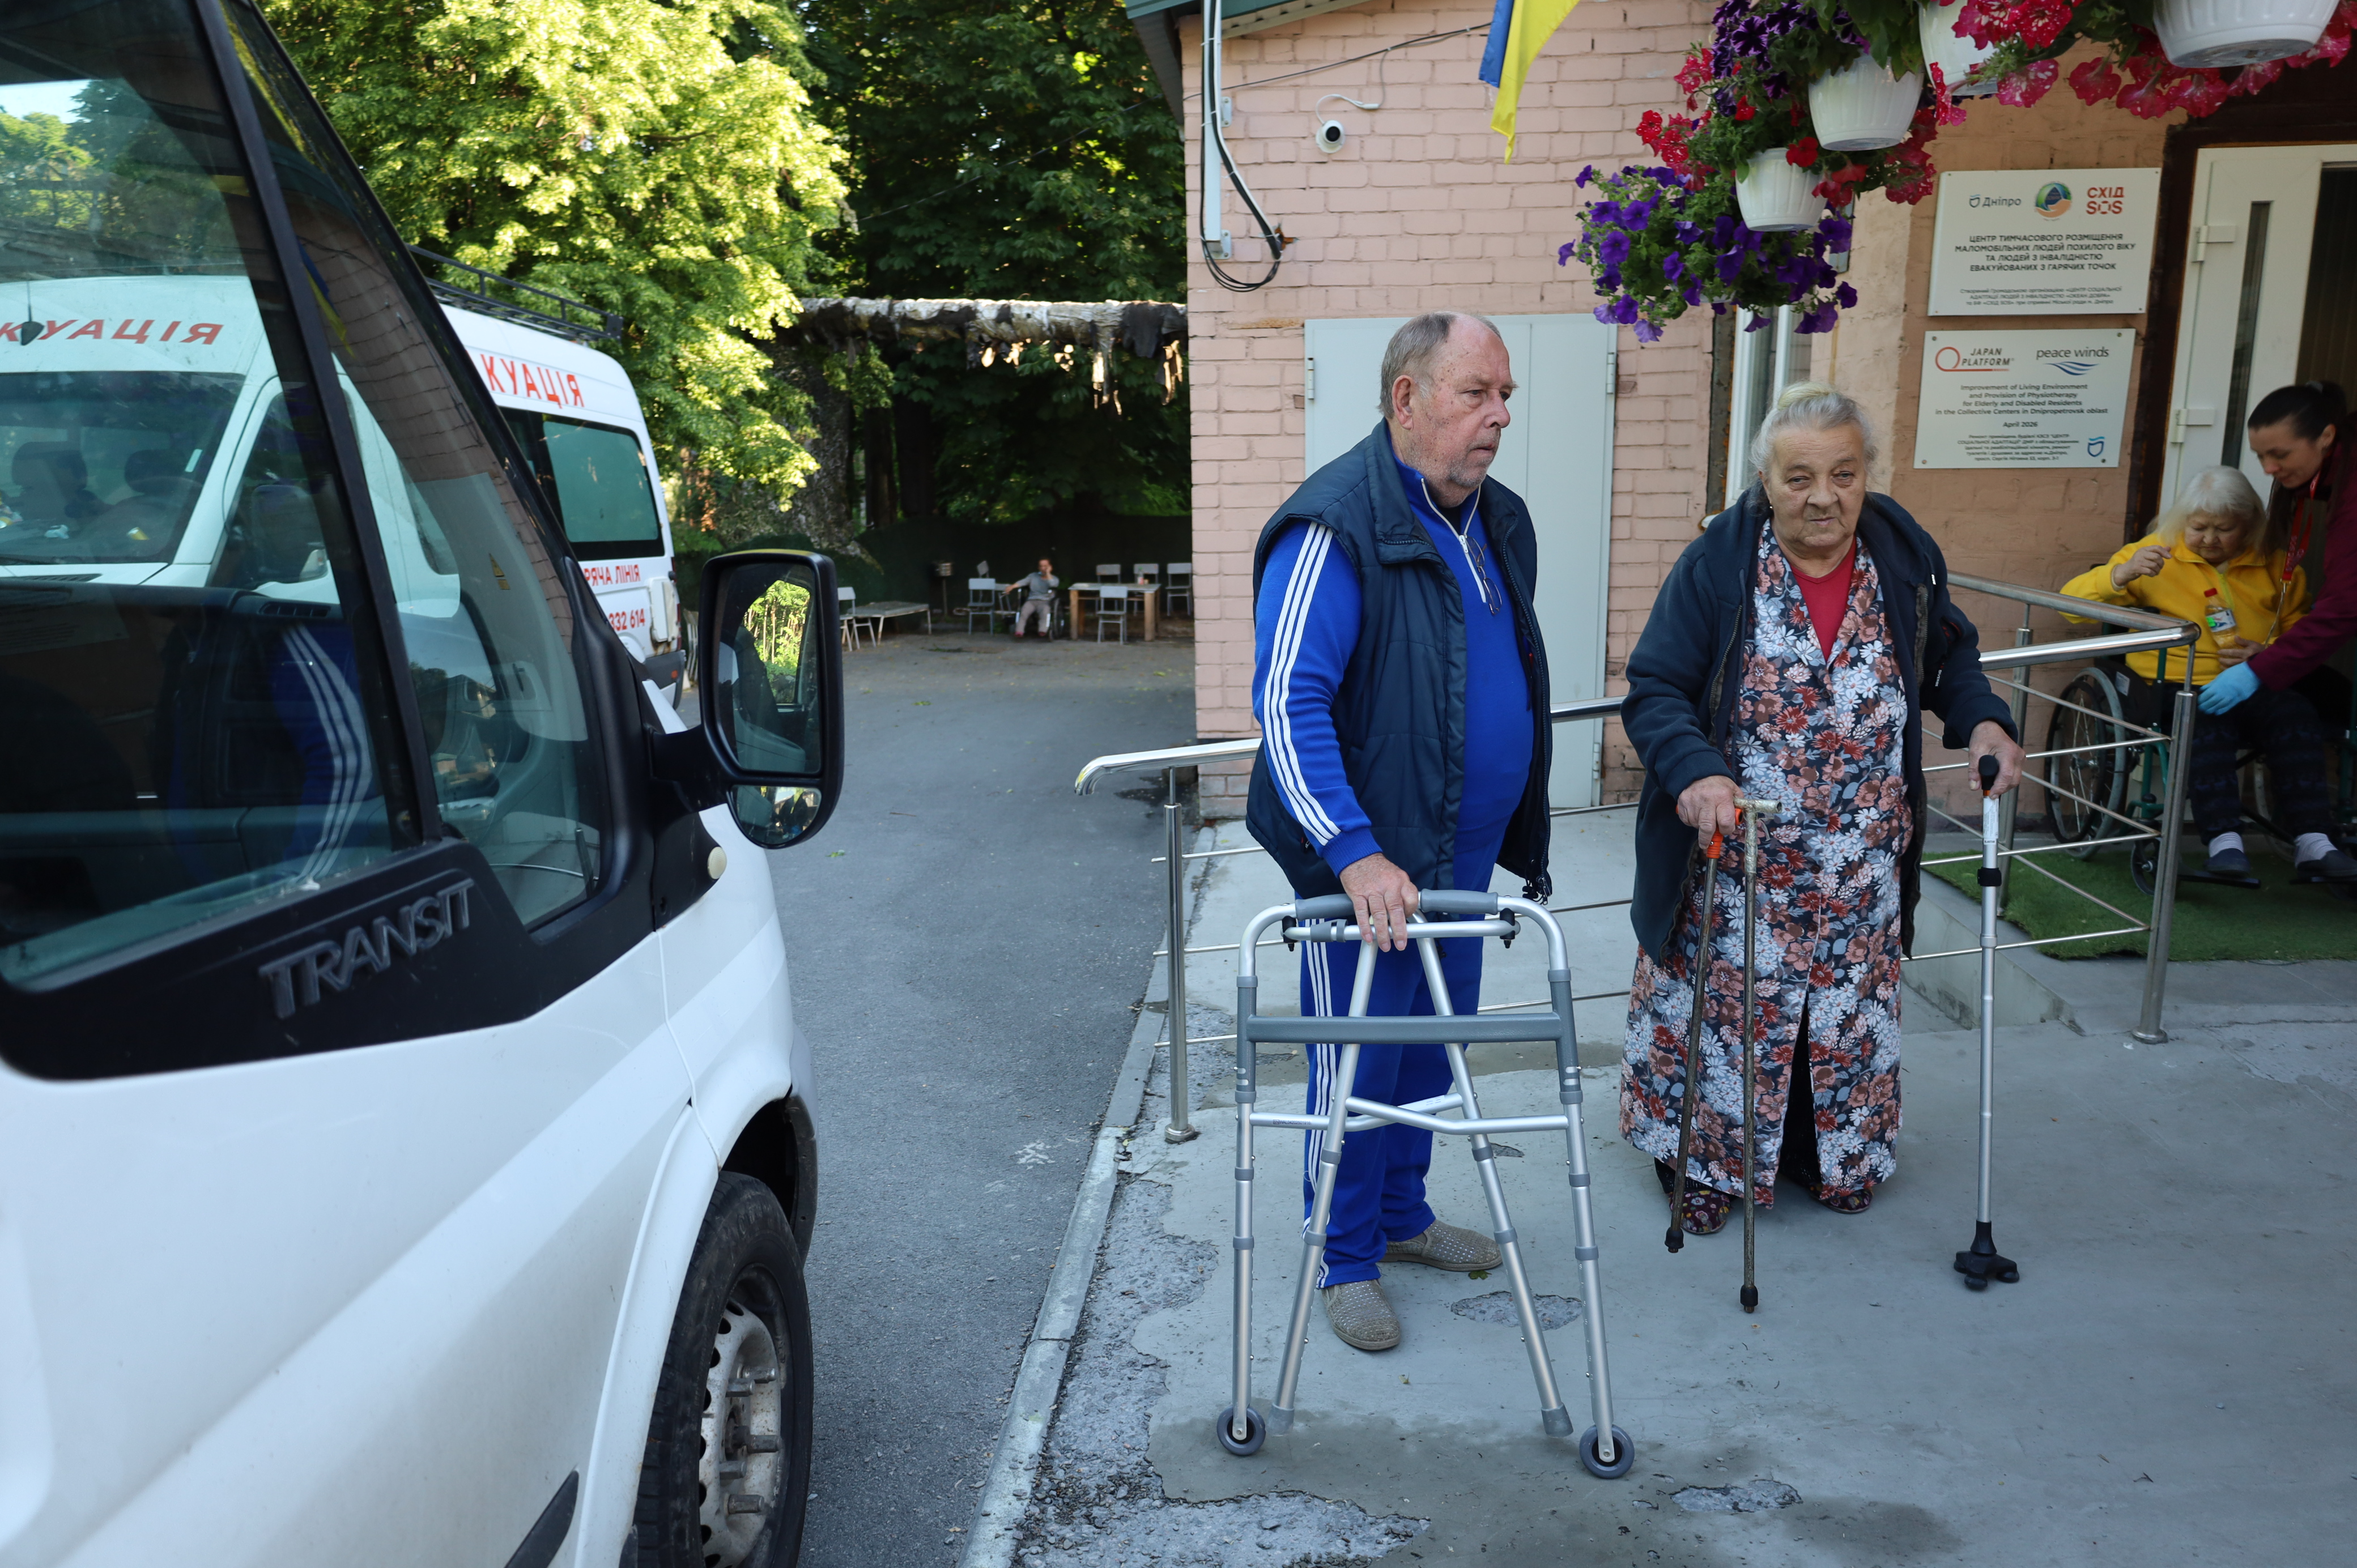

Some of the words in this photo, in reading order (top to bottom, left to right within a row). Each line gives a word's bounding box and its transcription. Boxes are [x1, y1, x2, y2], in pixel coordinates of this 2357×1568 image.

[2087, 186, 2125, 199] СХІД
[1982, 197, 2021, 207] Дніпро
[2086, 200, 2122, 215] SOS
[2066, 233, 2123, 242] РОЗМІЩЕННЯ
[2032, 242, 2064, 252] ЛЮДЕЙ
[1998, 253, 2030, 261] ЛЮДЕЙ
[1970, 263, 2038, 271] ЕВАКУЙОВАНИХ
[2036, 348, 2071, 360] peace
[2074, 347, 2109, 358] winds
[2030, 407, 2084, 416] Dnipropetrovsk
[615, 564, 641, 584] ЛІНІЯ
[630, 608, 645, 628] 614
[258, 877, 474, 1019] TRANSIT
